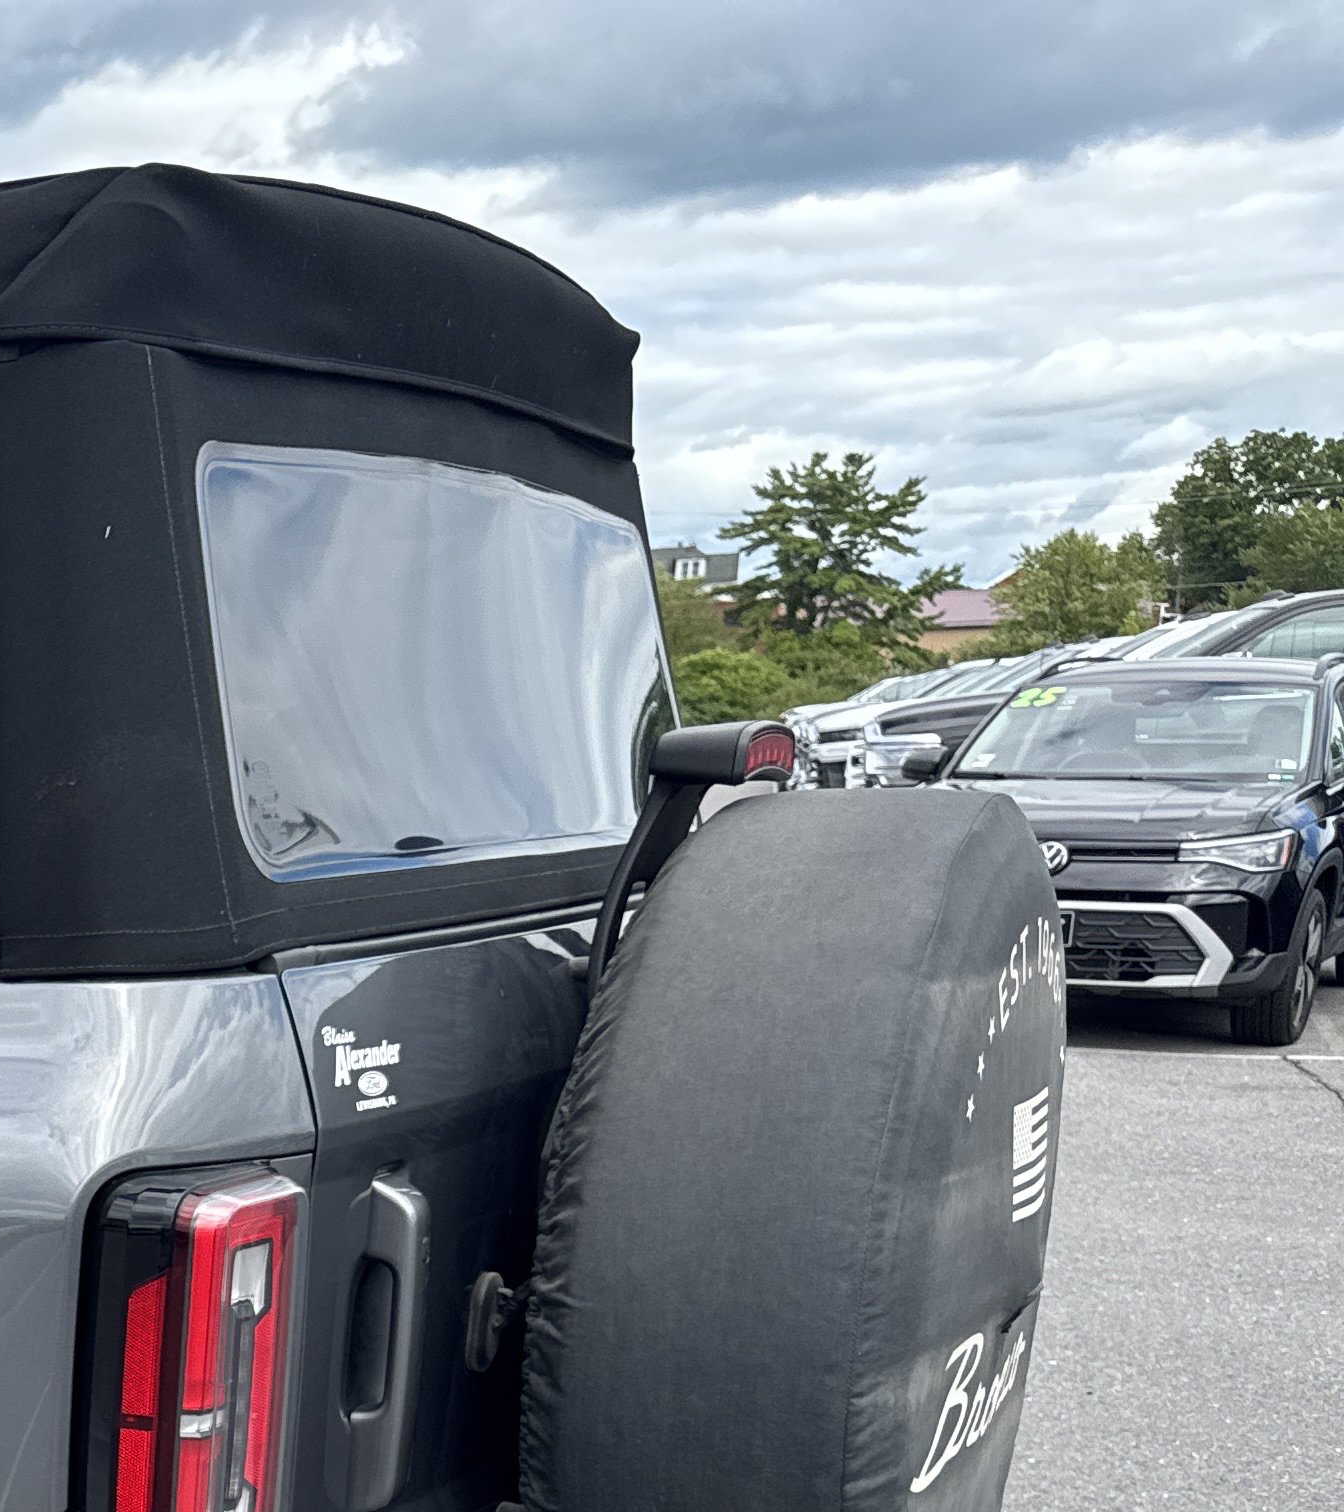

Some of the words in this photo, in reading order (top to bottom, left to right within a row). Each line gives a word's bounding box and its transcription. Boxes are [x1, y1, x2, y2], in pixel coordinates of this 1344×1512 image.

[1010, 686, 1067, 708] 25
[998, 924, 1033, 1033] EST.
[1037, 916, 1062, 1004] 1966
[334, 1039, 401, 1087] Alexander
[909, 1330, 1026, 1493] Bronco
